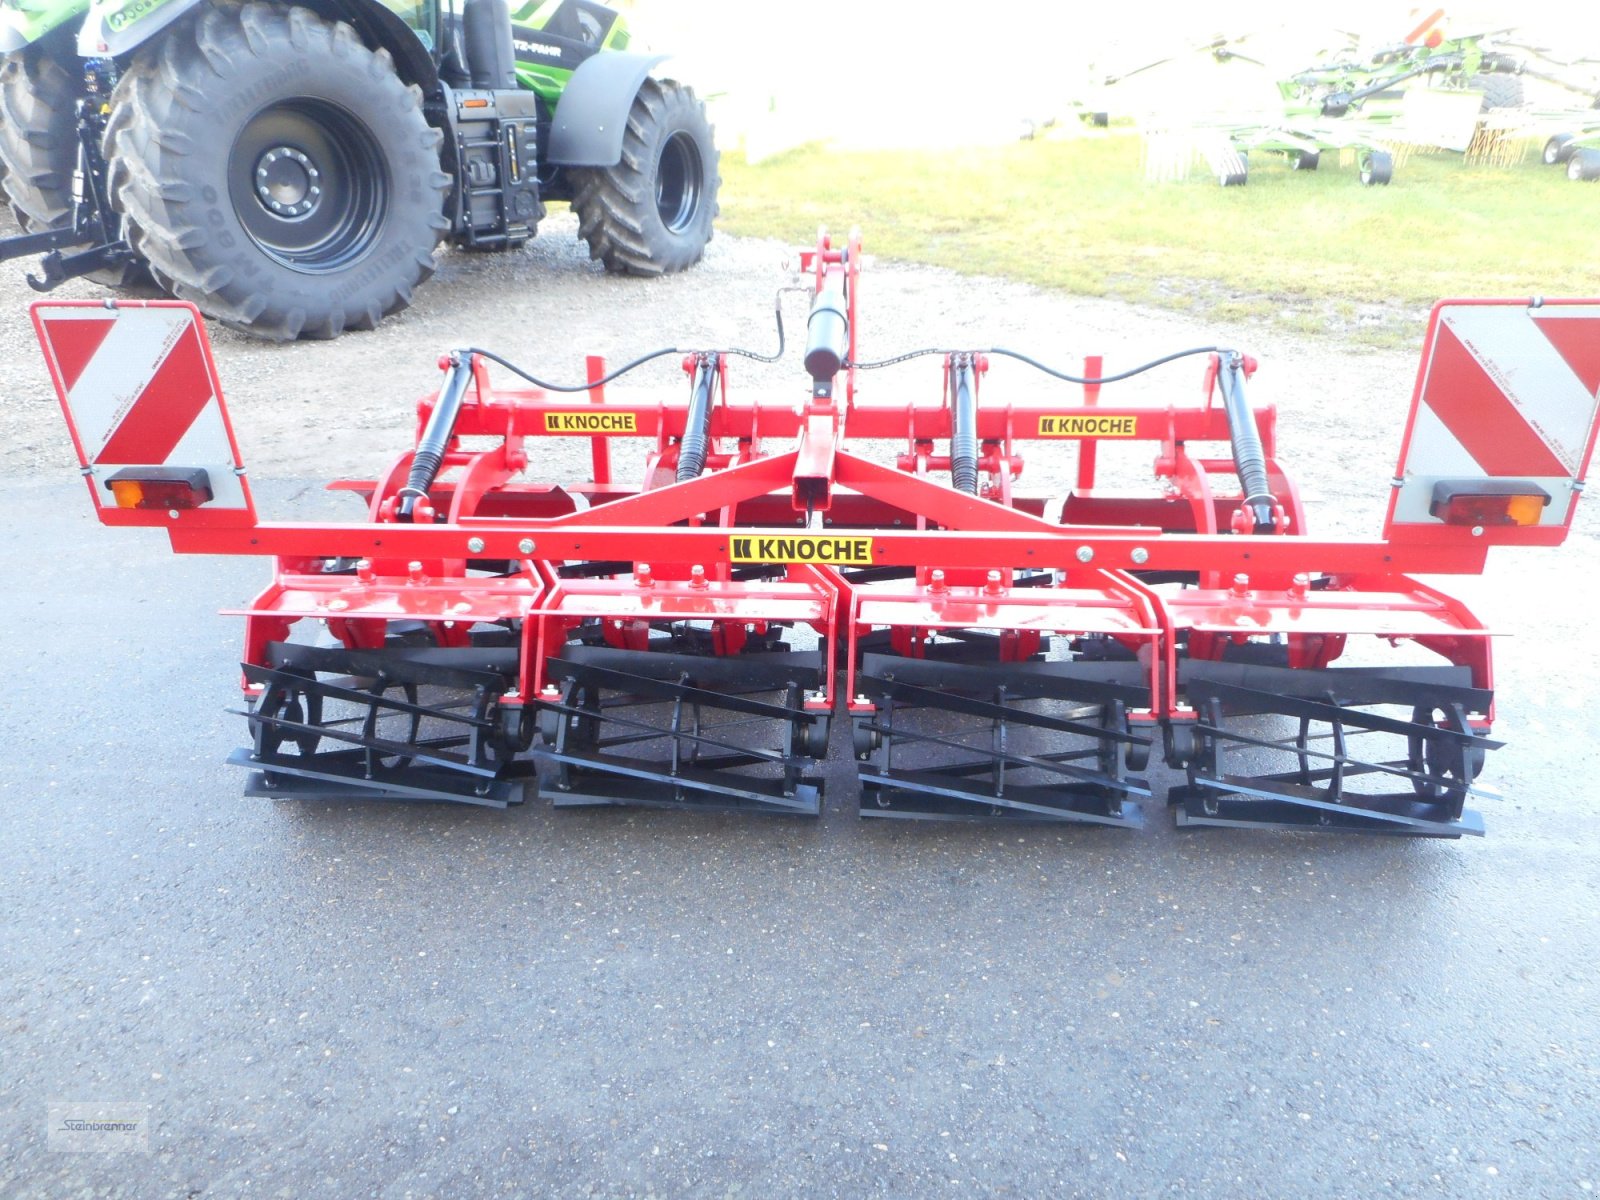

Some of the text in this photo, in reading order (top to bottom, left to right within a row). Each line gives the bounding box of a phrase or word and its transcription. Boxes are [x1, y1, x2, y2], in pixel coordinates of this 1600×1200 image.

[563, 415, 633, 429] KNOCHE
[1058, 419, 1133, 433] KNOCHE
[758, 539, 868, 560] KNOCHE
